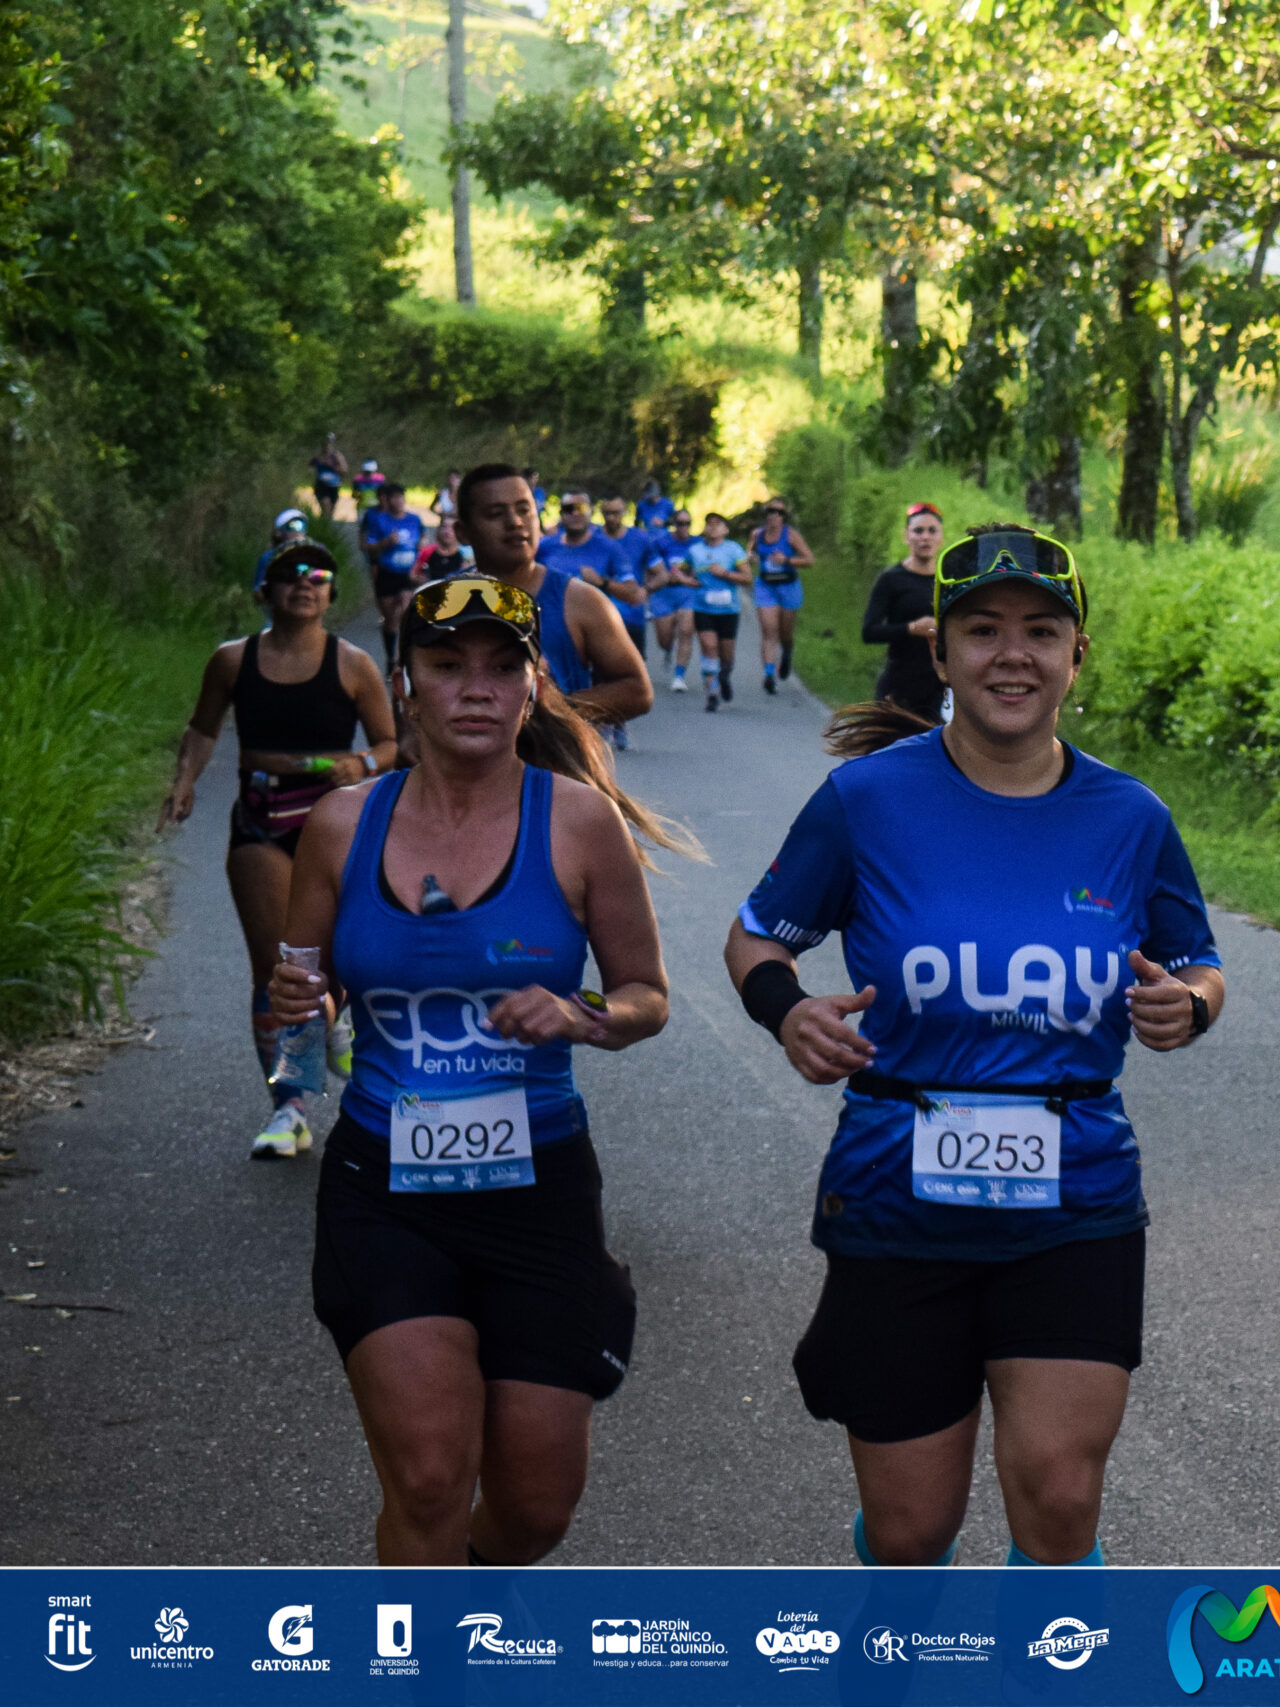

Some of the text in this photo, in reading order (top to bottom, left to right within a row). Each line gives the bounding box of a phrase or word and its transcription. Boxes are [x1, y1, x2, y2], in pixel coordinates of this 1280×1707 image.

[423, 1053, 525, 1073] en tu vida
[411, 1119, 516, 1160] 0292
[937, 1130, 1045, 1173] 0253
